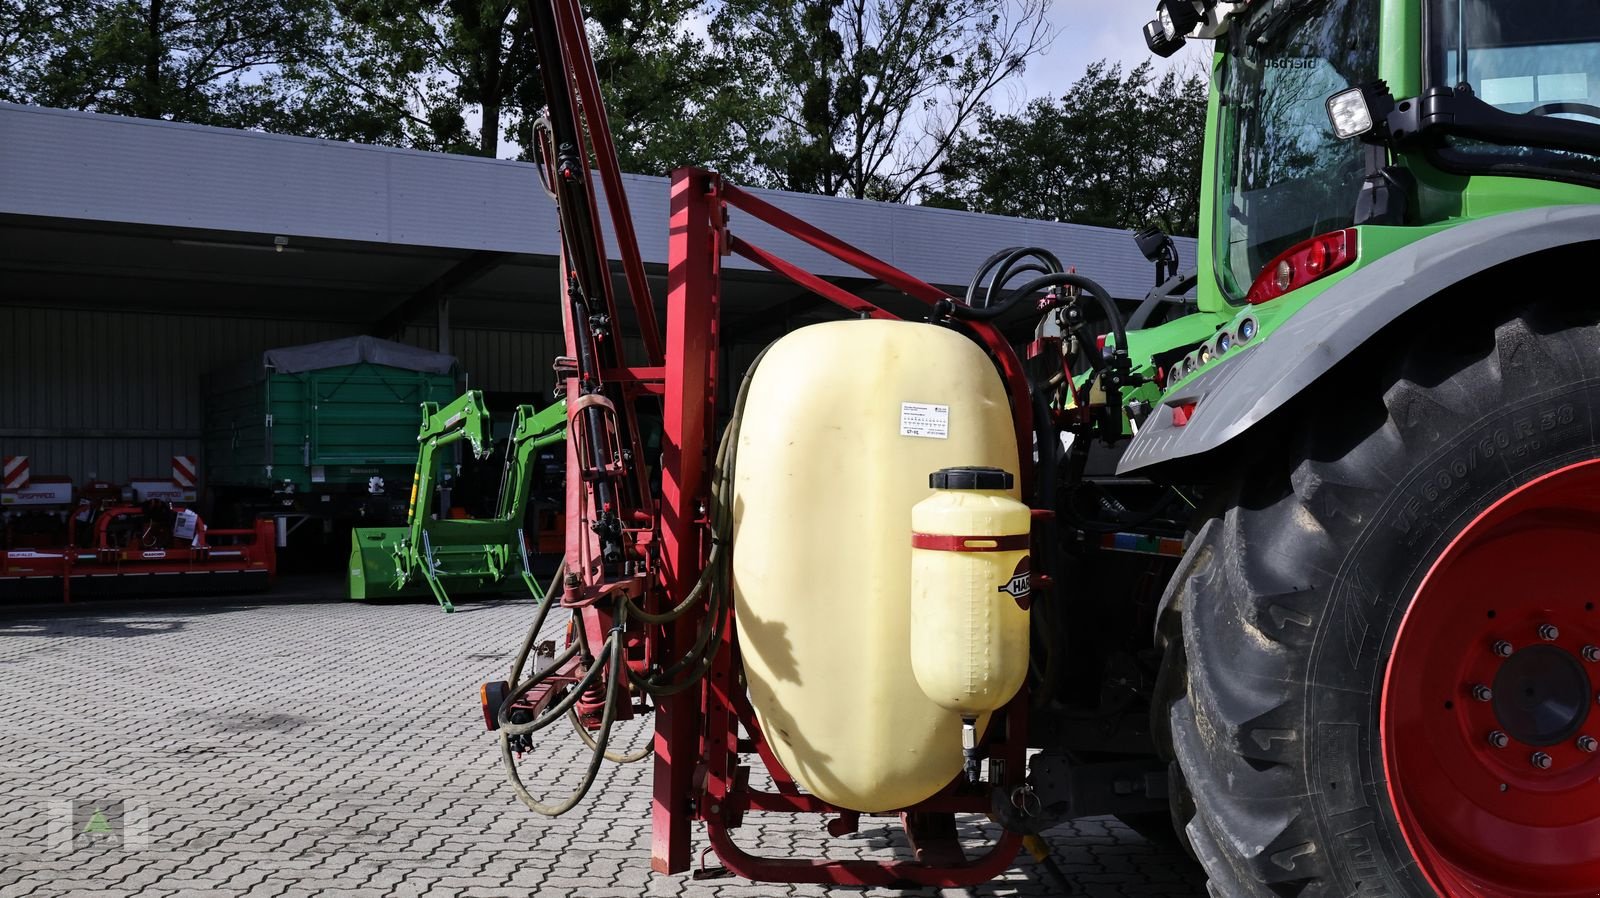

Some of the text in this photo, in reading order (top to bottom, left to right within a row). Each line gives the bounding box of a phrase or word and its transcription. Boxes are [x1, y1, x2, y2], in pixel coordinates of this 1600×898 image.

[1392, 496, 1422, 534] VF
[1422, 429, 1510, 502] 600/60
[1513, 419, 1535, 440] R
[1539, 404, 1575, 431] 38
